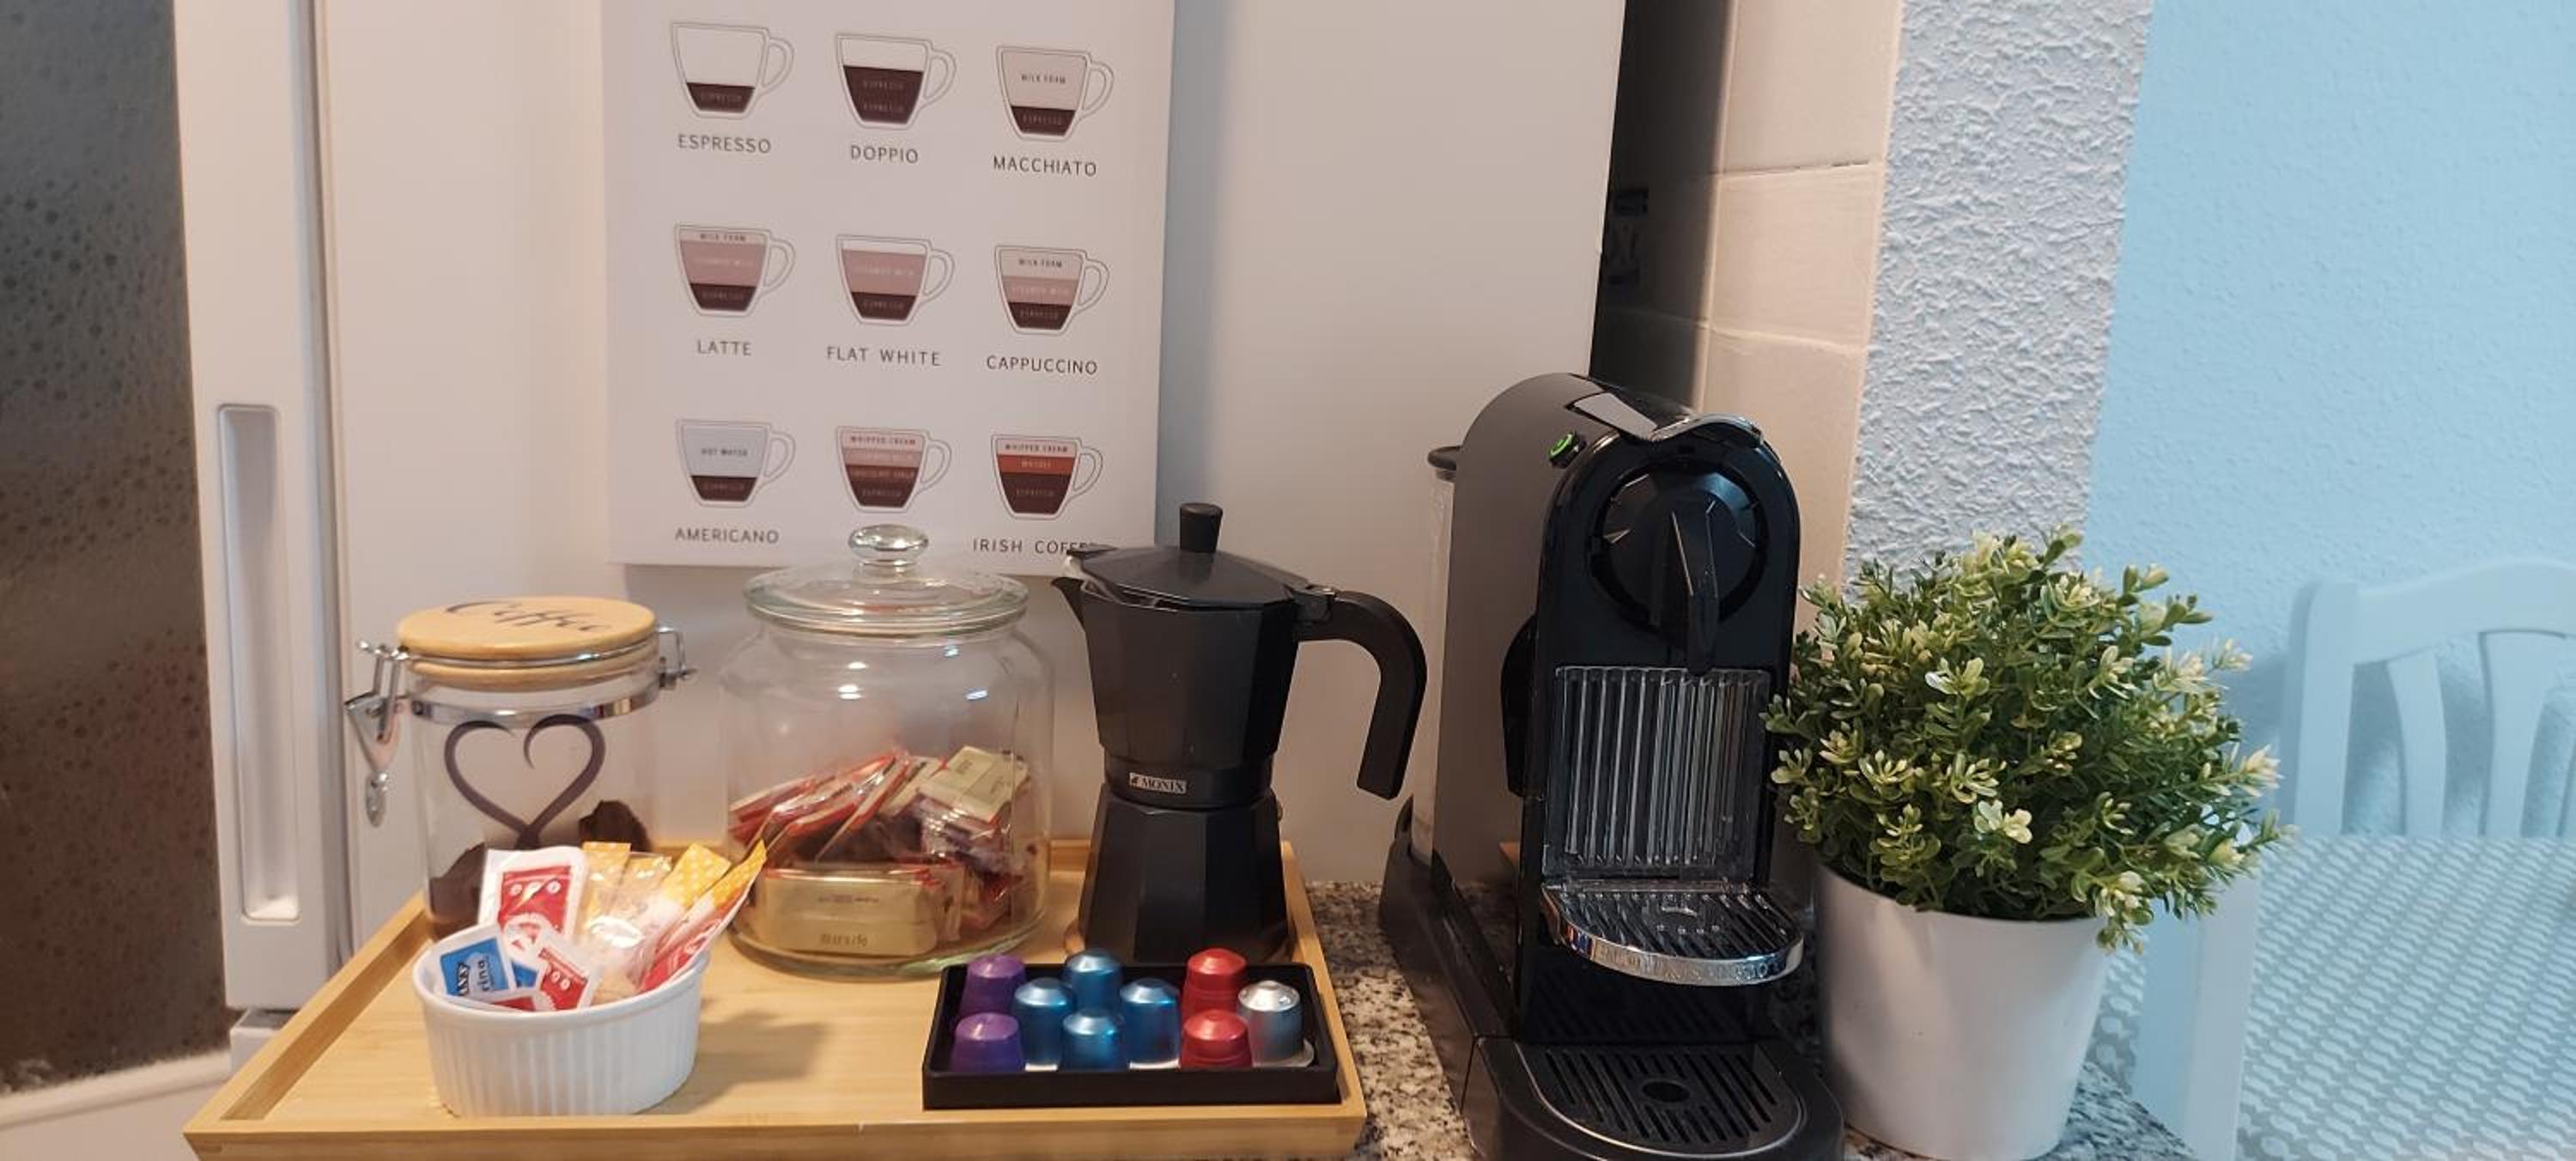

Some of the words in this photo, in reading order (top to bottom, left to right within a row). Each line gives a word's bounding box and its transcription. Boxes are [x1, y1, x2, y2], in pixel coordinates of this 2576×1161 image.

[677, 134, 771, 154] ESPRESSO
[851, 145, 919, 164] DOPPIO
[993, 155, 1097, 177] MACCHIATO
[696, 340, 752, 357] LATTE
[826, 346, 870, 362] FLAT
[879, 349, 942, 367] WHITE
[987, 355, 1098, 375] CAPPUCCINO
[674, 527, 780, 544] AMERICANO
[972, 538, 1023, 553] IRISH
